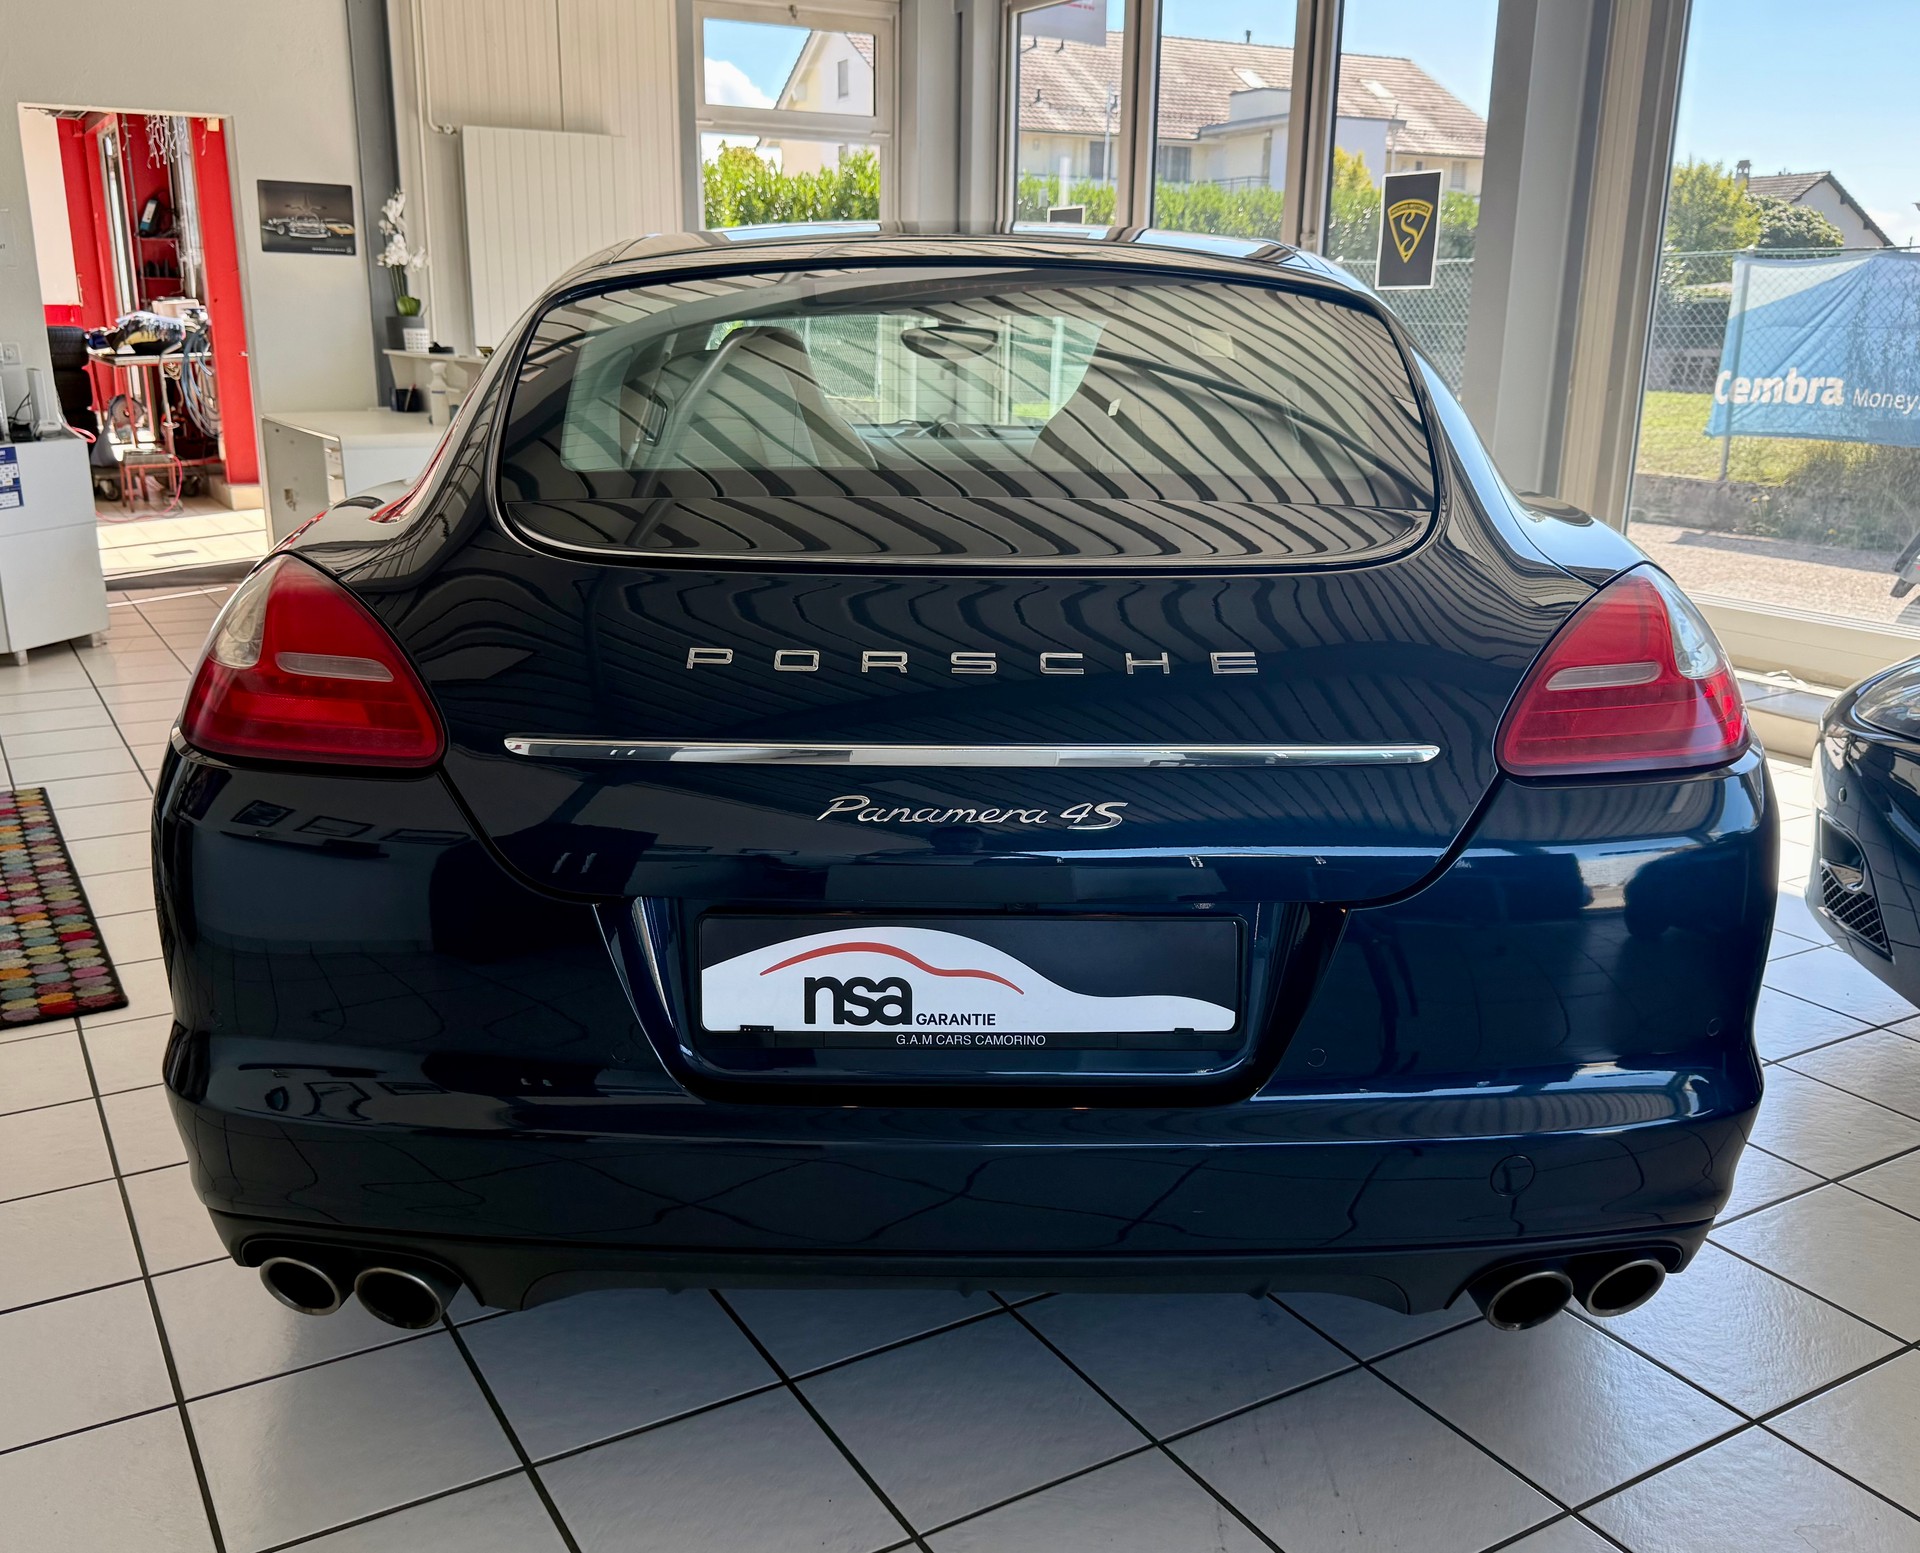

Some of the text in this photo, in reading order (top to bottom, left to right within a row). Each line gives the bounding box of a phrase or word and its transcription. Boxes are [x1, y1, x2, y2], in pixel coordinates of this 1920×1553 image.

[1714, 367, 1845, 406] Cembra
[686, 647, 1259, 676] PORSCHE
[816, 795, 1129, 830] Panamera 4S
[804, 976, 996, 1026] nsa GARANTIE
[896, 1034, 1046, 1047] G.A.M CARS CAMORINO
